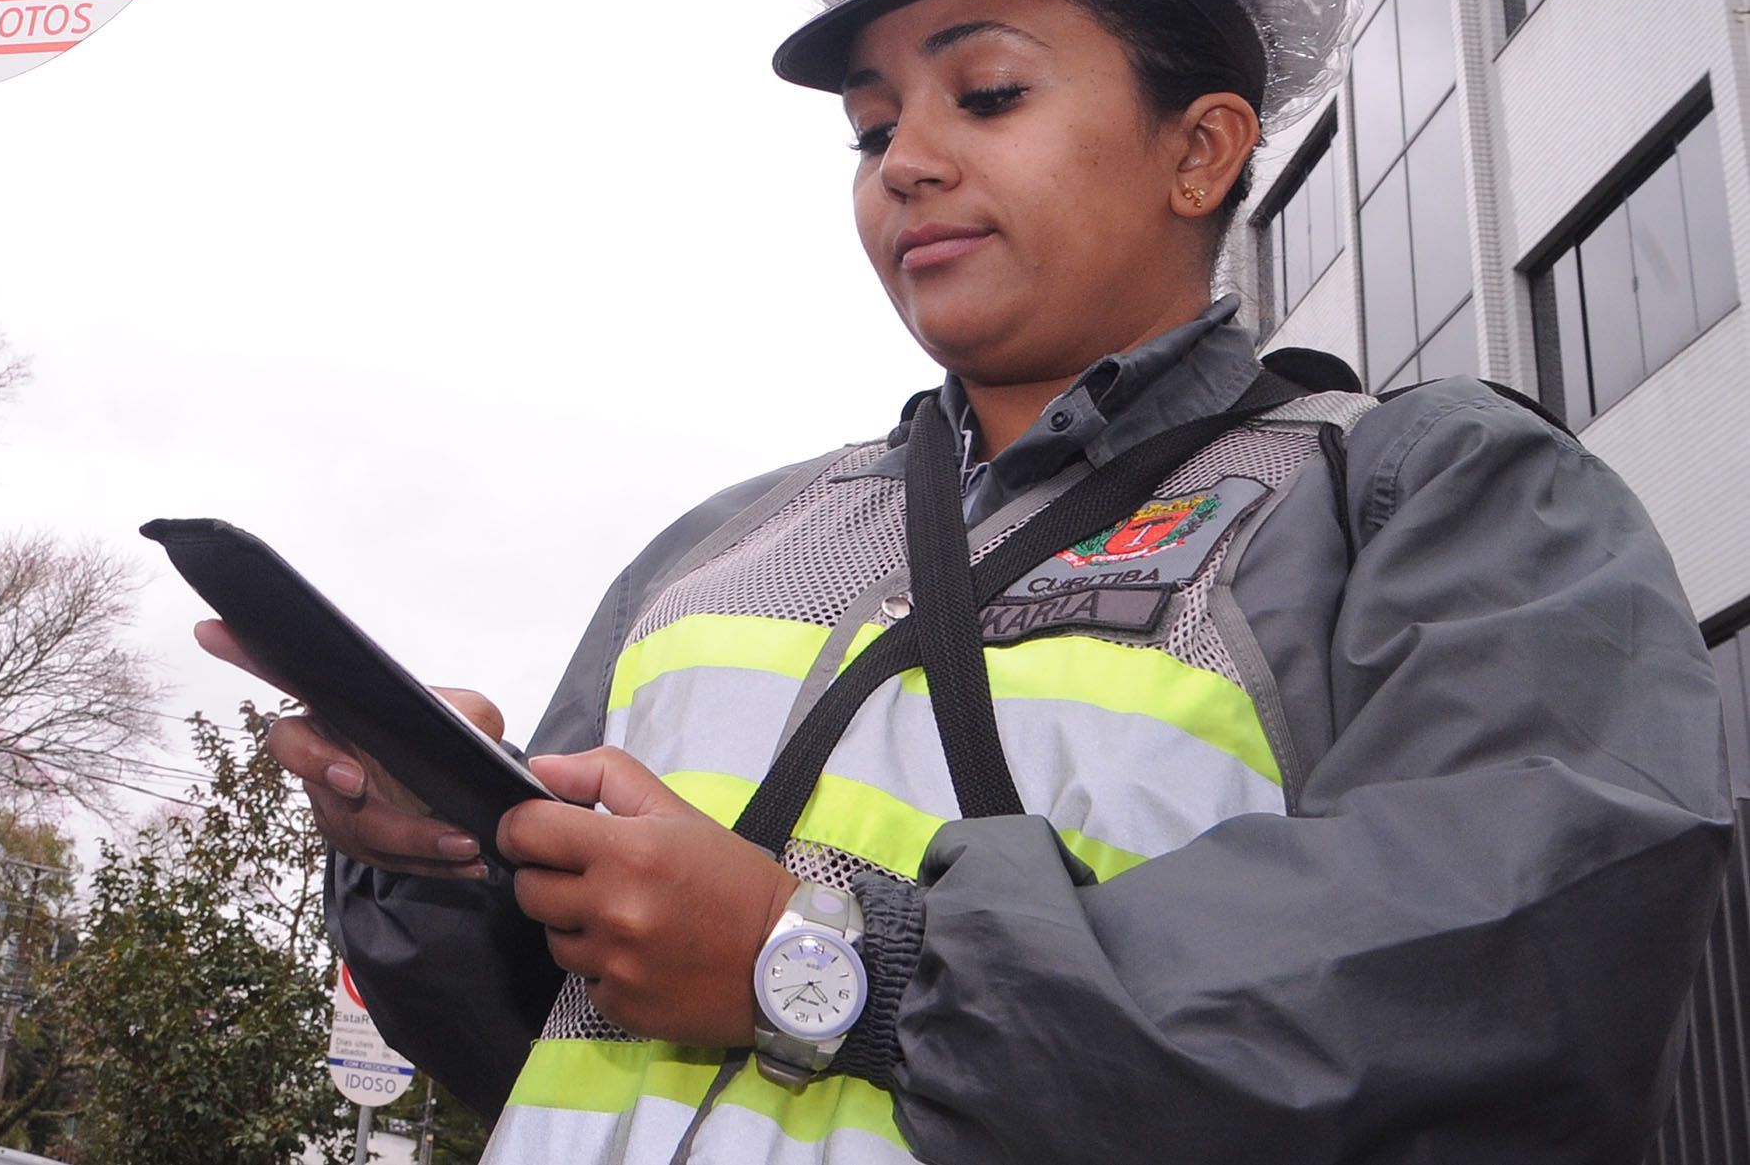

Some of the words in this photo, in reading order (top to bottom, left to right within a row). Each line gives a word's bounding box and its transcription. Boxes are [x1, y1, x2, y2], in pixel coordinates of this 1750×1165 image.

[981, 591, 1099, 635] KARLA
[334, 1011, 370, 1025] EstaR
[345, 1073, 397, 1094] IDOSO
